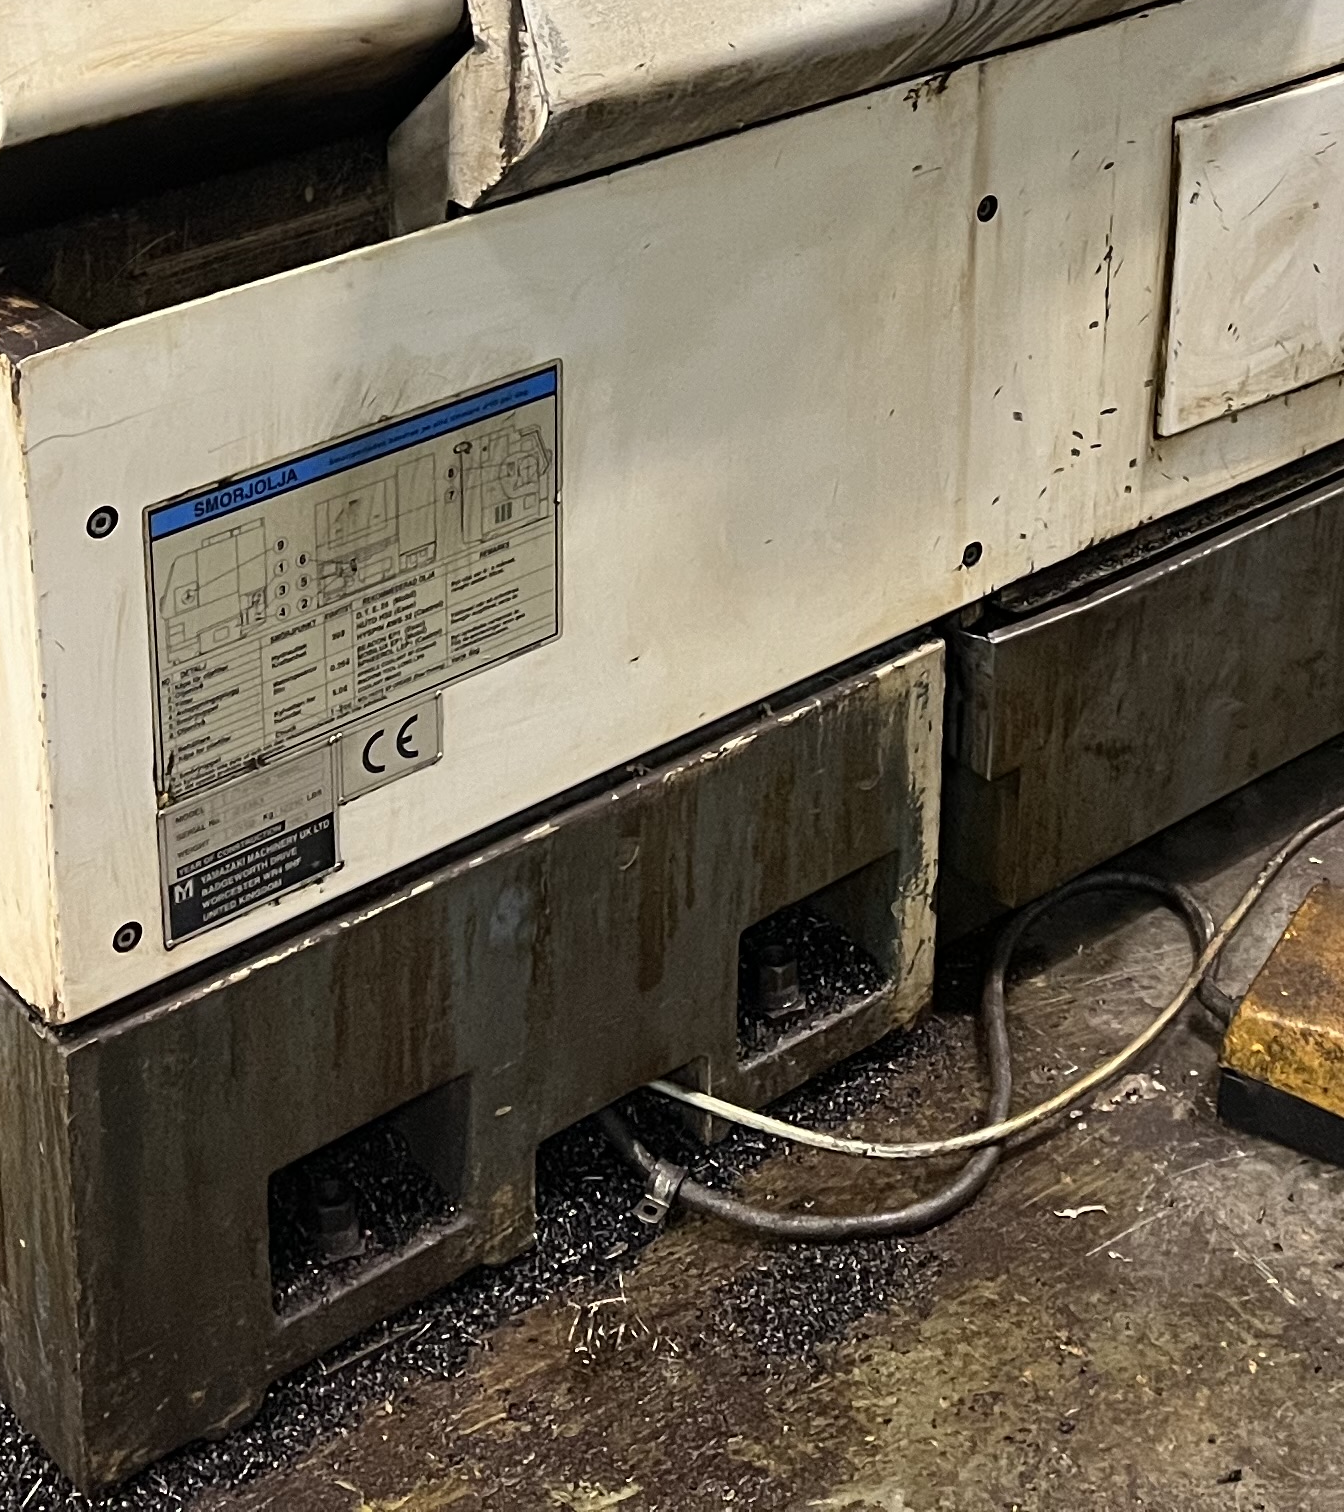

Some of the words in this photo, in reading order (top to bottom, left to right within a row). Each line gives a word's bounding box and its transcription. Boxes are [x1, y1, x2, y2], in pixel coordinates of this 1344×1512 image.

[179, 860, 201, 875] YEAR
[217, 825, 281, 858] CONSTRUCTION
[201, 857, 245, 883] YAMAZAKI
[247, 834, 297, 863] MACHINERY
[299, 827, 312, 839] UK
[314, 819, 329, 833] LTD
[202, 860, 268, 896] BADGEWORTH
[270, 847, 297, 865] DRIVE
[202, 876, 260, 908] WORCESTER
[203, 900, 236, 921] UNITED
[239, 879, 282, 904] KINGDOM
